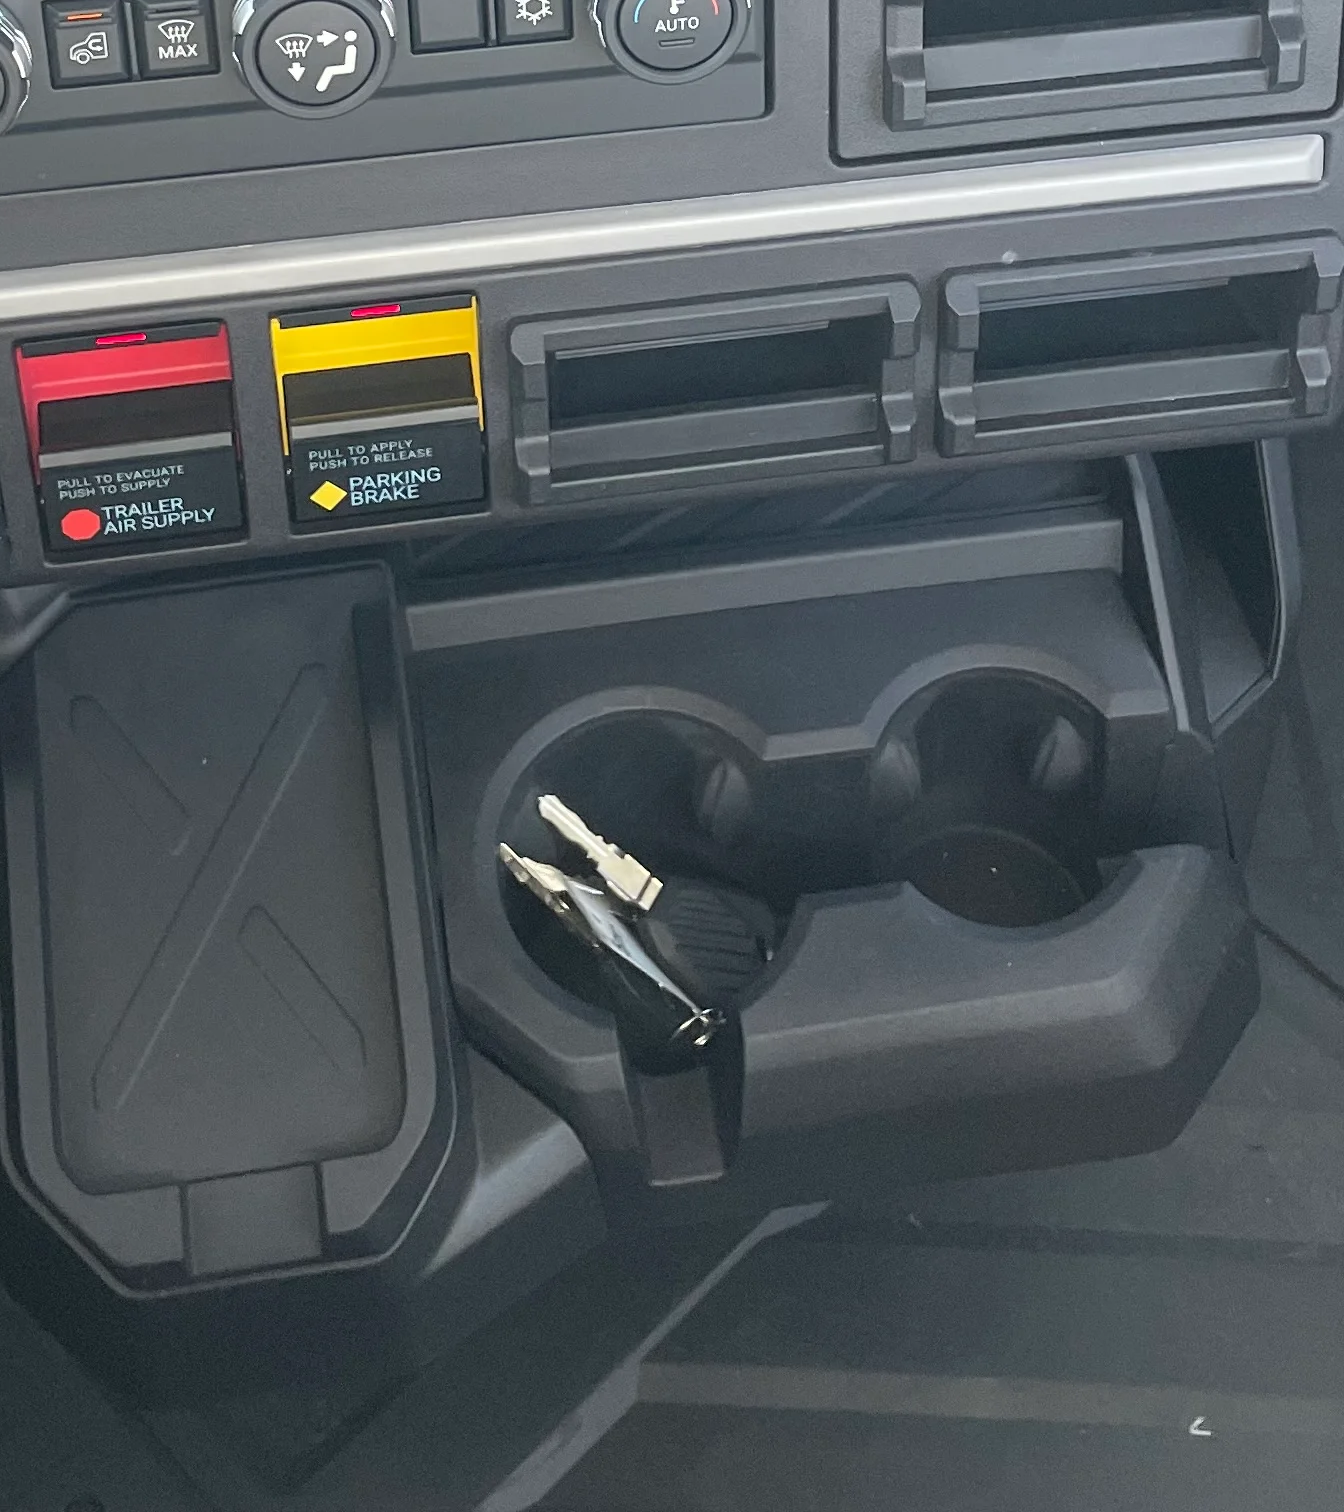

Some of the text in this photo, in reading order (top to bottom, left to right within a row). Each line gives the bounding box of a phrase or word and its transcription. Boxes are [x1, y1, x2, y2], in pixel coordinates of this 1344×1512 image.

[654, 16, 700, 33] AUTO
[157, 44, 198, 60] MAX
[308, 439, 413, 461] PULL TO APPLY
[309, 447, 433, 472] PUSH TO RELEASE
[57, 464, 185, 489] PULL TO EVACUATE
[349, 466, 442, 492] PARKING
[58, 477, 171, 500] PUSH TO SUPPLY
[350, 483, 420, 507] BRAKE
[101, 497, 184, 520] TRAILER
[103, 507, 215, 536] AIR SUPPLY
